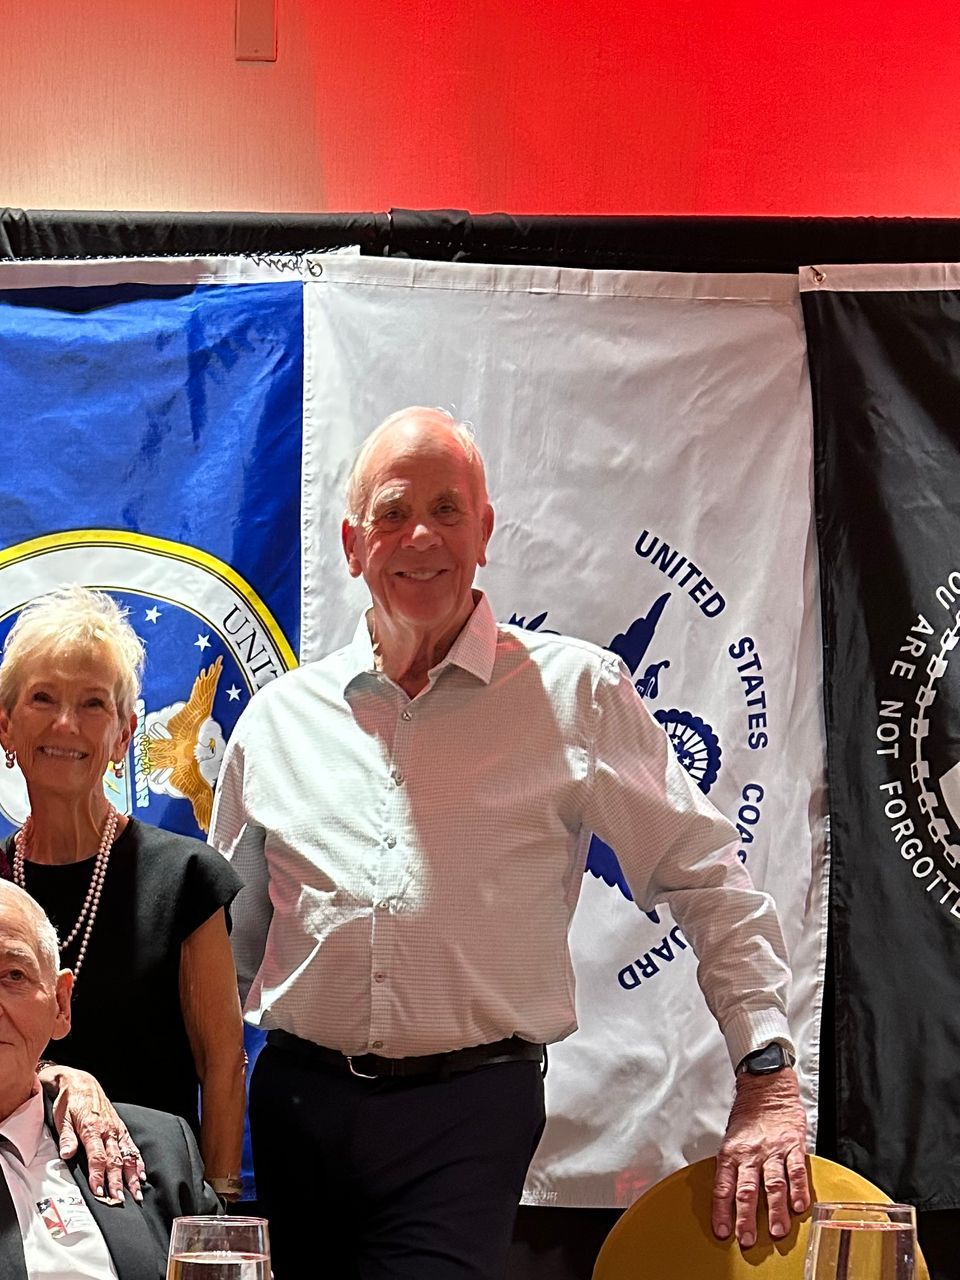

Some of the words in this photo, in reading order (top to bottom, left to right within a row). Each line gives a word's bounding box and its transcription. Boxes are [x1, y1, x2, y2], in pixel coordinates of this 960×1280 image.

[635, 530, 726, 618] UNITED
[890, 614, 934, 680] ARE
[729, 637, 768, 749] STATES
[877, 701, 904, 758] NOT
[618, 925, 687, 990] UARD
